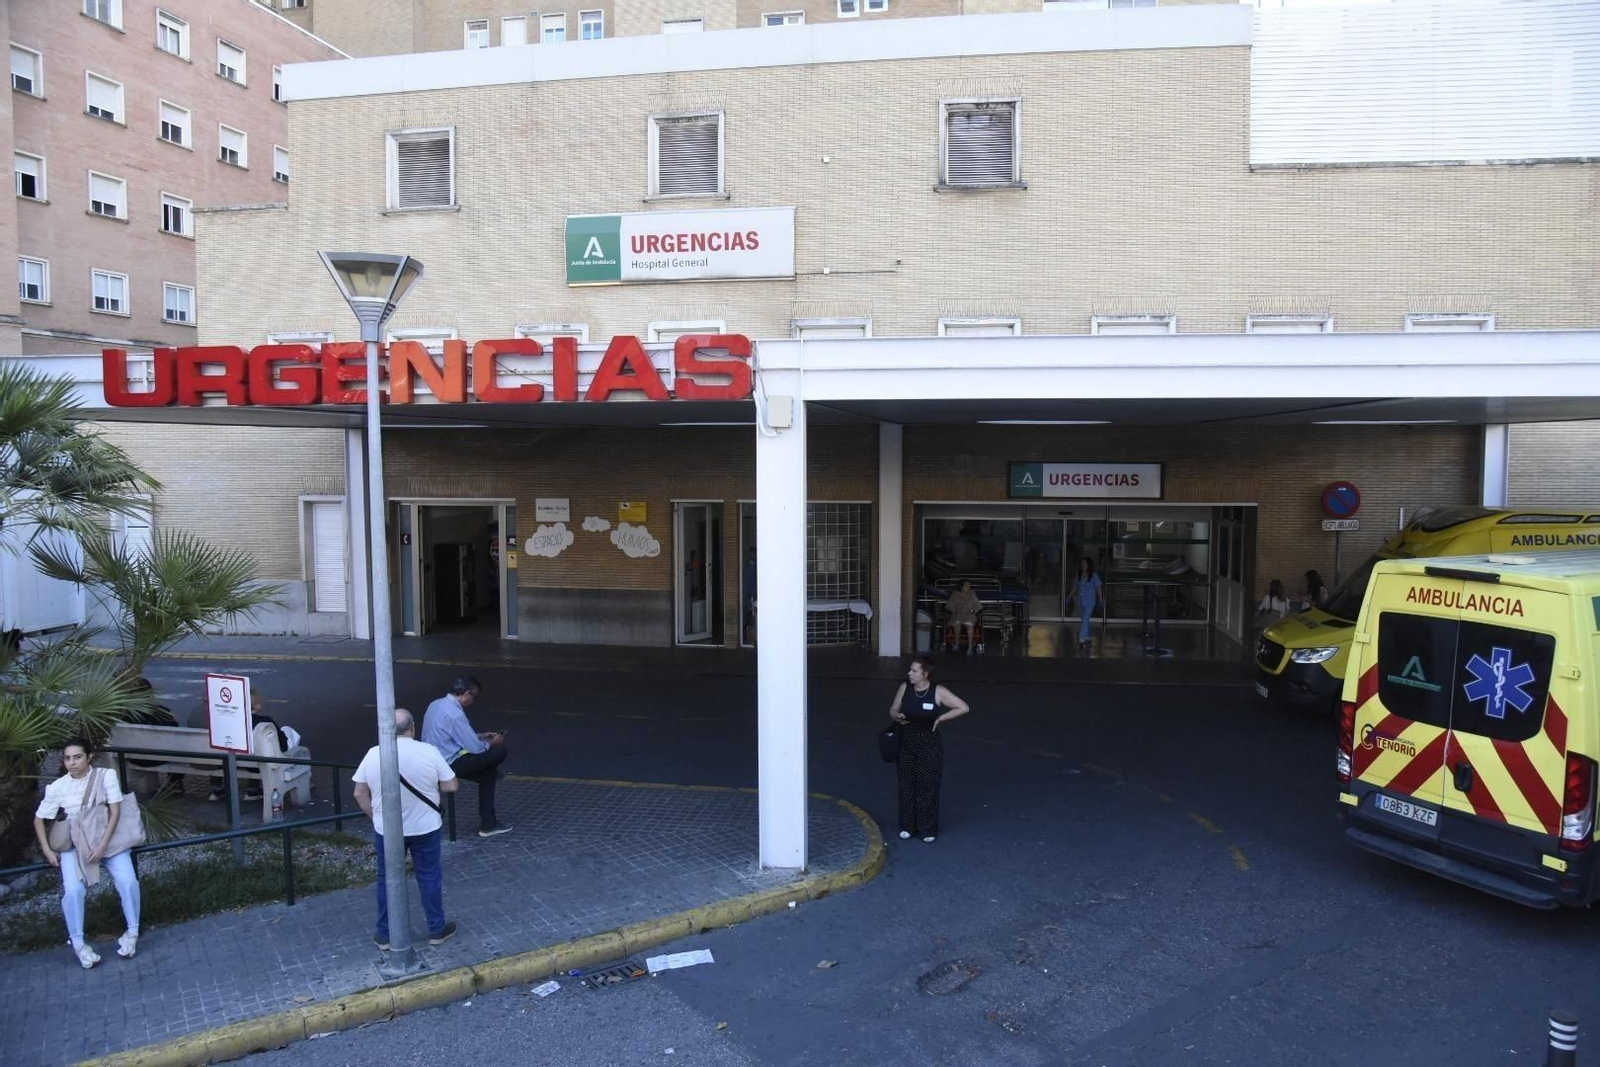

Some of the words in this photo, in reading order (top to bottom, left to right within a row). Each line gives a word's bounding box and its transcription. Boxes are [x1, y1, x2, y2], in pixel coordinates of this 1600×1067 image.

[631, 231, 759, 253] URGENCIAS
[631, 259, 670, 270] Hospital
[672, 257, 708, 268] General
[102, 333, 754, 407] URGENCIAS
[1049, 473, 1139, 486] URGENCIAS
[1406, 587, 1524, 617] AMBULANCIA
[1377, 736, 1416, 757] TENORIO
[1383, 798, 1410, 816] 0863
[1413, 806, 1435, 823] KZF
